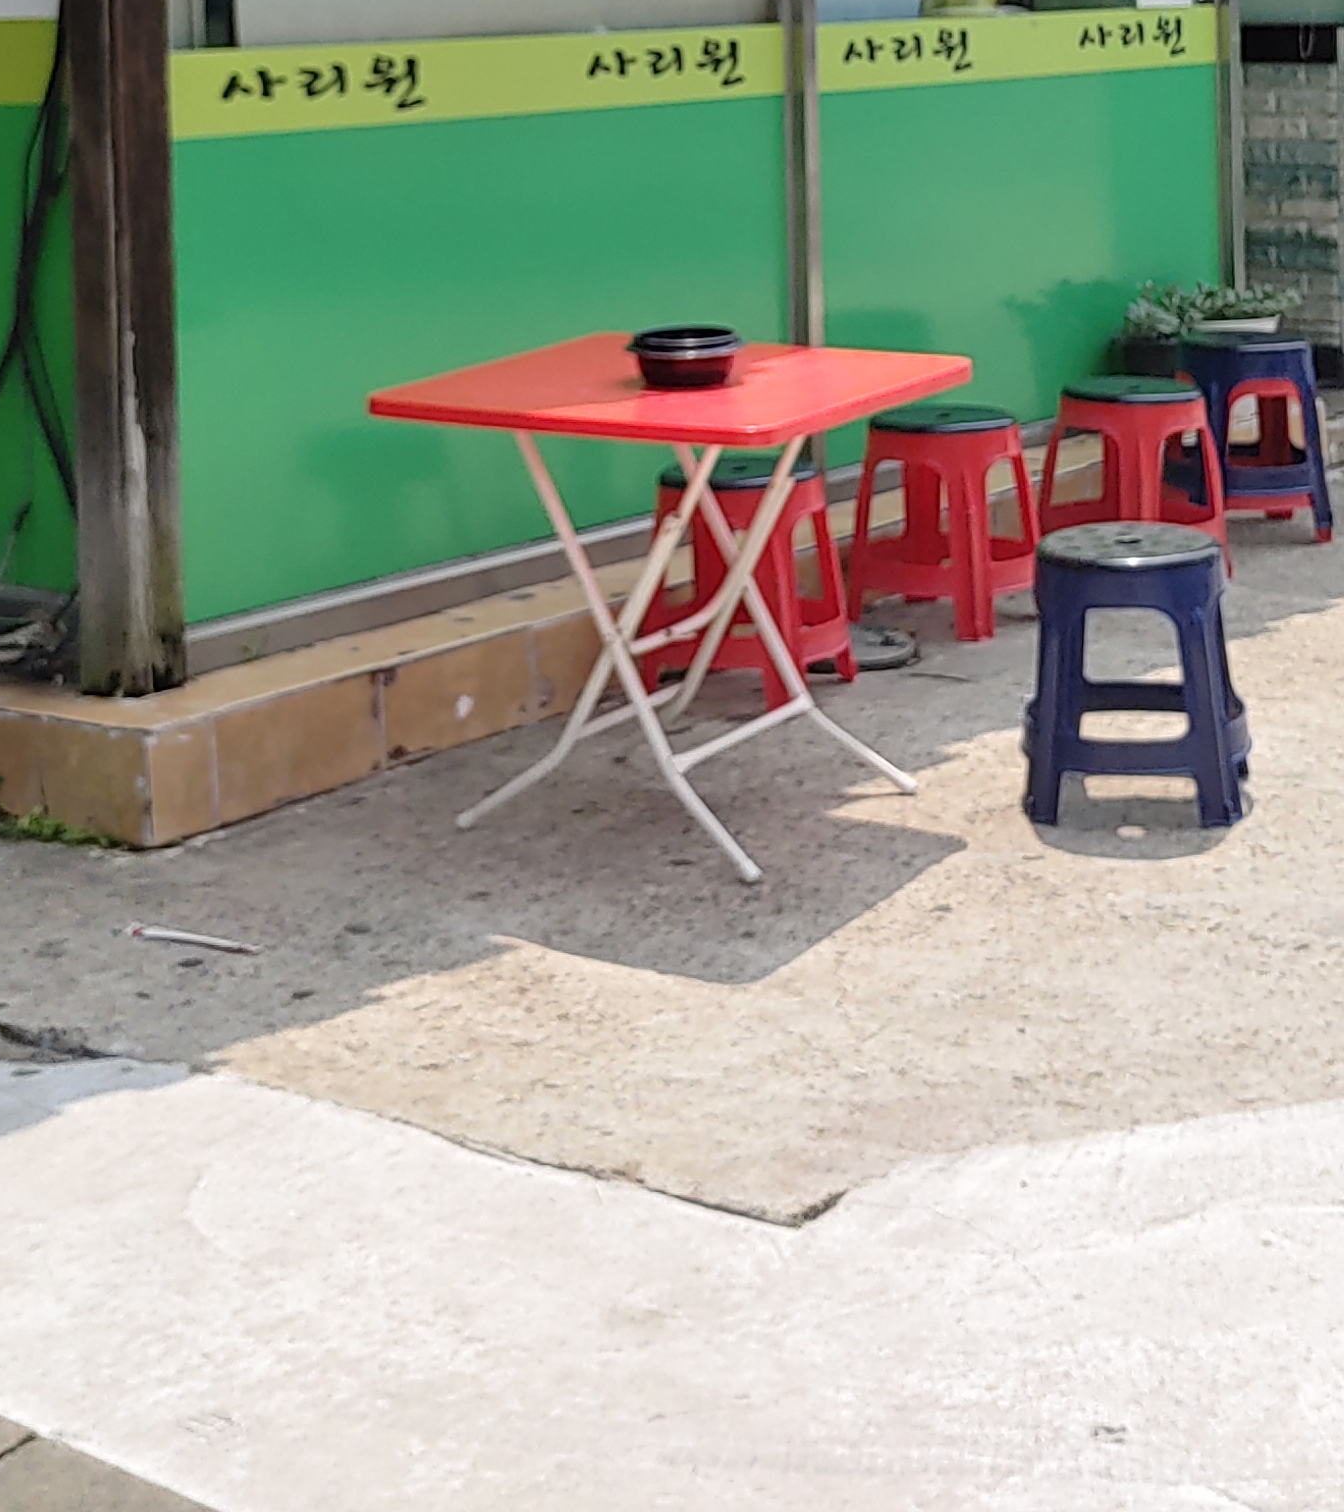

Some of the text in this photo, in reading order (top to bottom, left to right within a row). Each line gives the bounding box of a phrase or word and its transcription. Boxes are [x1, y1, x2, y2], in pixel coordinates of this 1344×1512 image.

[843, 29, 973, 72] 사리원
[1079, 15, 1187, 57] 사리원
[221, 53, 427, 111] 사리원
[587, 38, 747, 88] 사리원
